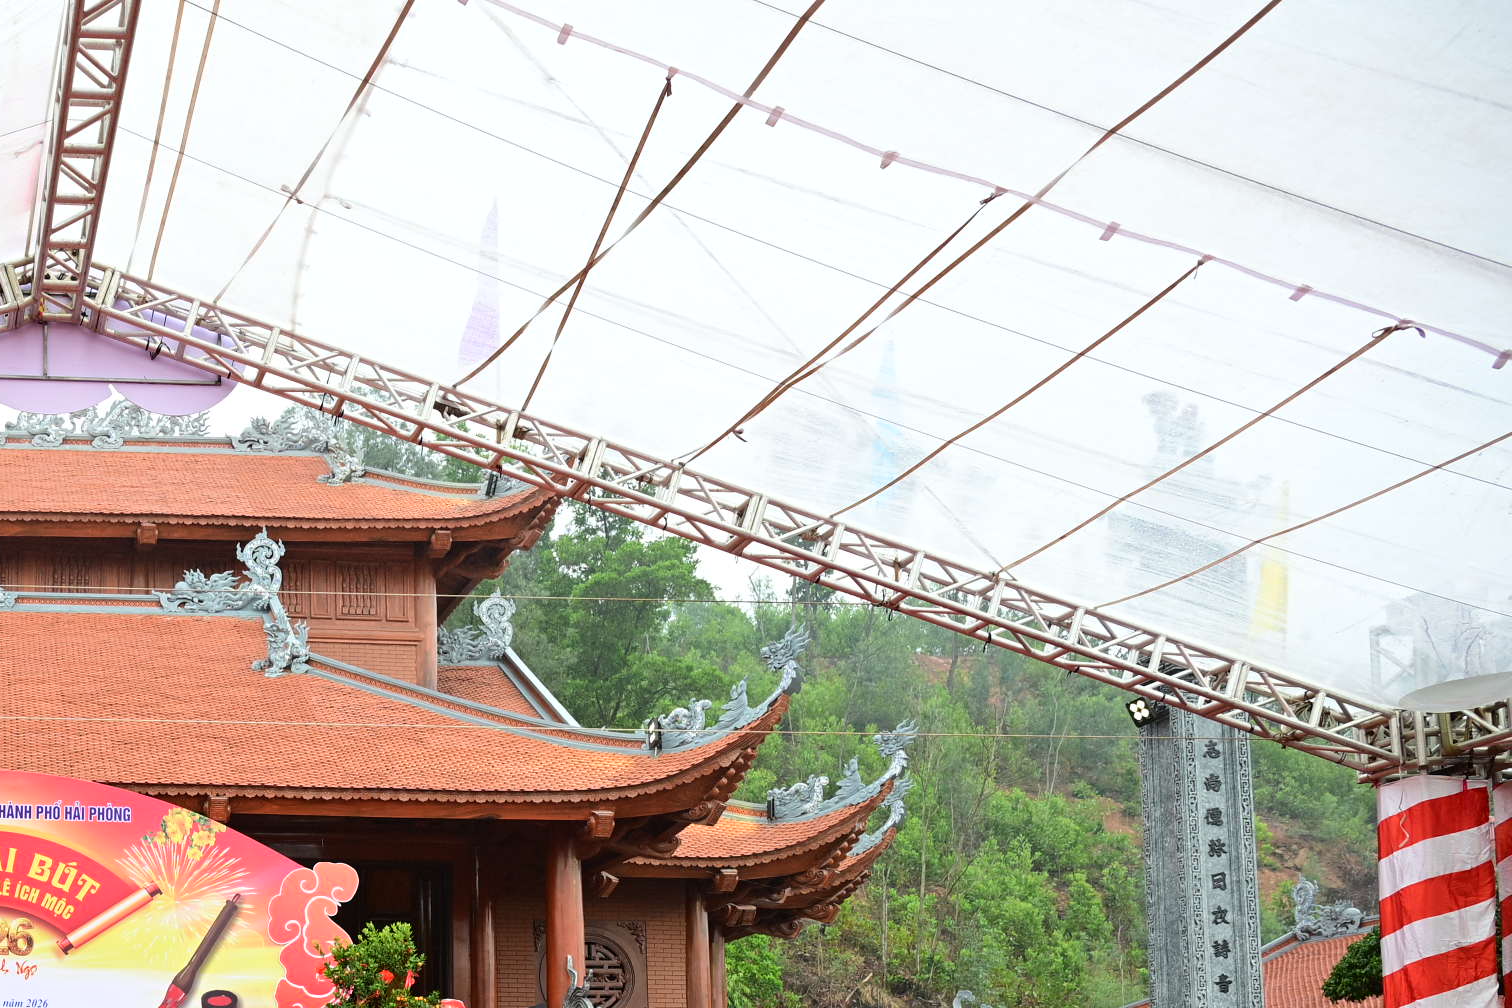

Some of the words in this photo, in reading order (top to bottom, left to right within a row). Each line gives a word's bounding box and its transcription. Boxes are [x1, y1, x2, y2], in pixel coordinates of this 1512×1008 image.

[36, 800, 61, 821] PHỐ
[65, 804, 85, 822] HẢI
[89, 804, 132, 822] PHÒNG
[27, 852, 101, 901] BÚT
[15, 880, 39, 904] ÍCH
[41, 894, 75, 920] MỘC
[16, 961, 38, 981] Ngọ
[2, 998, 23, 1008] năm
[26, 998, 49, 1008] 2026
